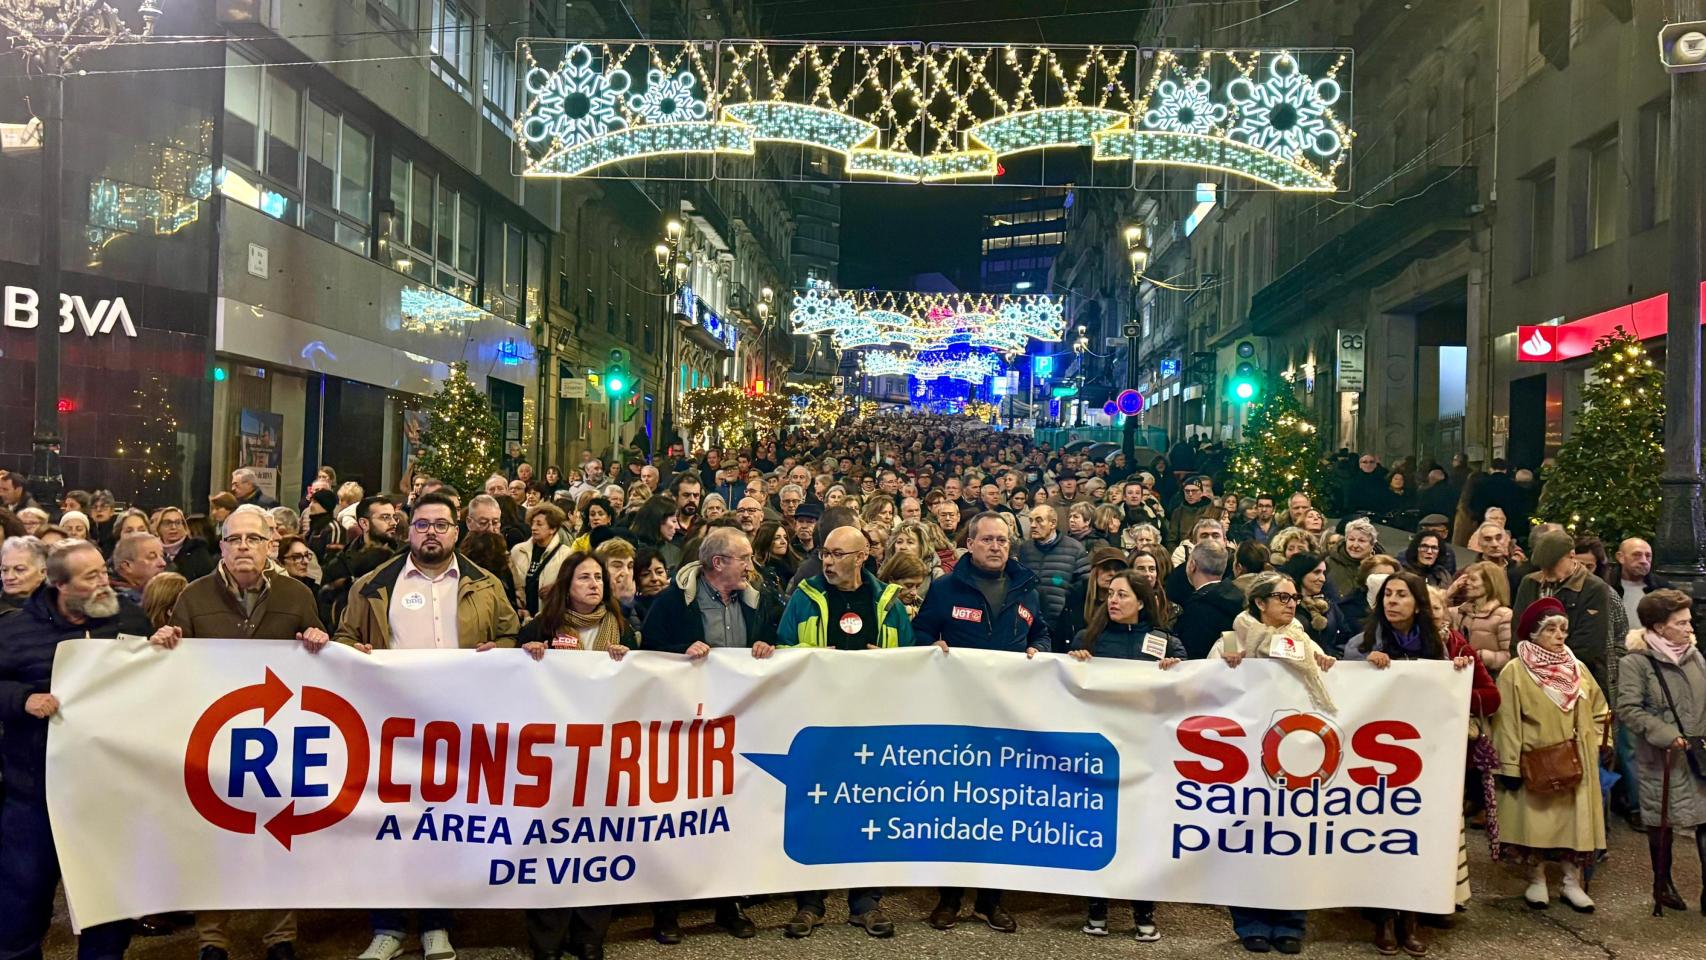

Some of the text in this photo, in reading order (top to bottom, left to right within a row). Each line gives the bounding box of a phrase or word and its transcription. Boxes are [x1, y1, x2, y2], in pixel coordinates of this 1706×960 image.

[4, 285, 137, 337] BBVA
[952, 606, 972, 619] UGT
[1018, 605, 1031, 620] UGT
[880, 743, 991, 767] Atención
[1000, 746, 1104, 775] Primaria
[833, 779, 945, 804] Atención
[953, 781, 1104, 811] Hospitalaria
[1175, 775, 1422, 818] sanidade
[375, 806, 731, 846] A ÁREA ASANITARIA
[887, 816, 1004, 842] Sanidade
[1011, 819, 1103, 848] Pública
[1172, 820, 1419, 859] pública
[488, 855, 637, 886] DE VIGO
